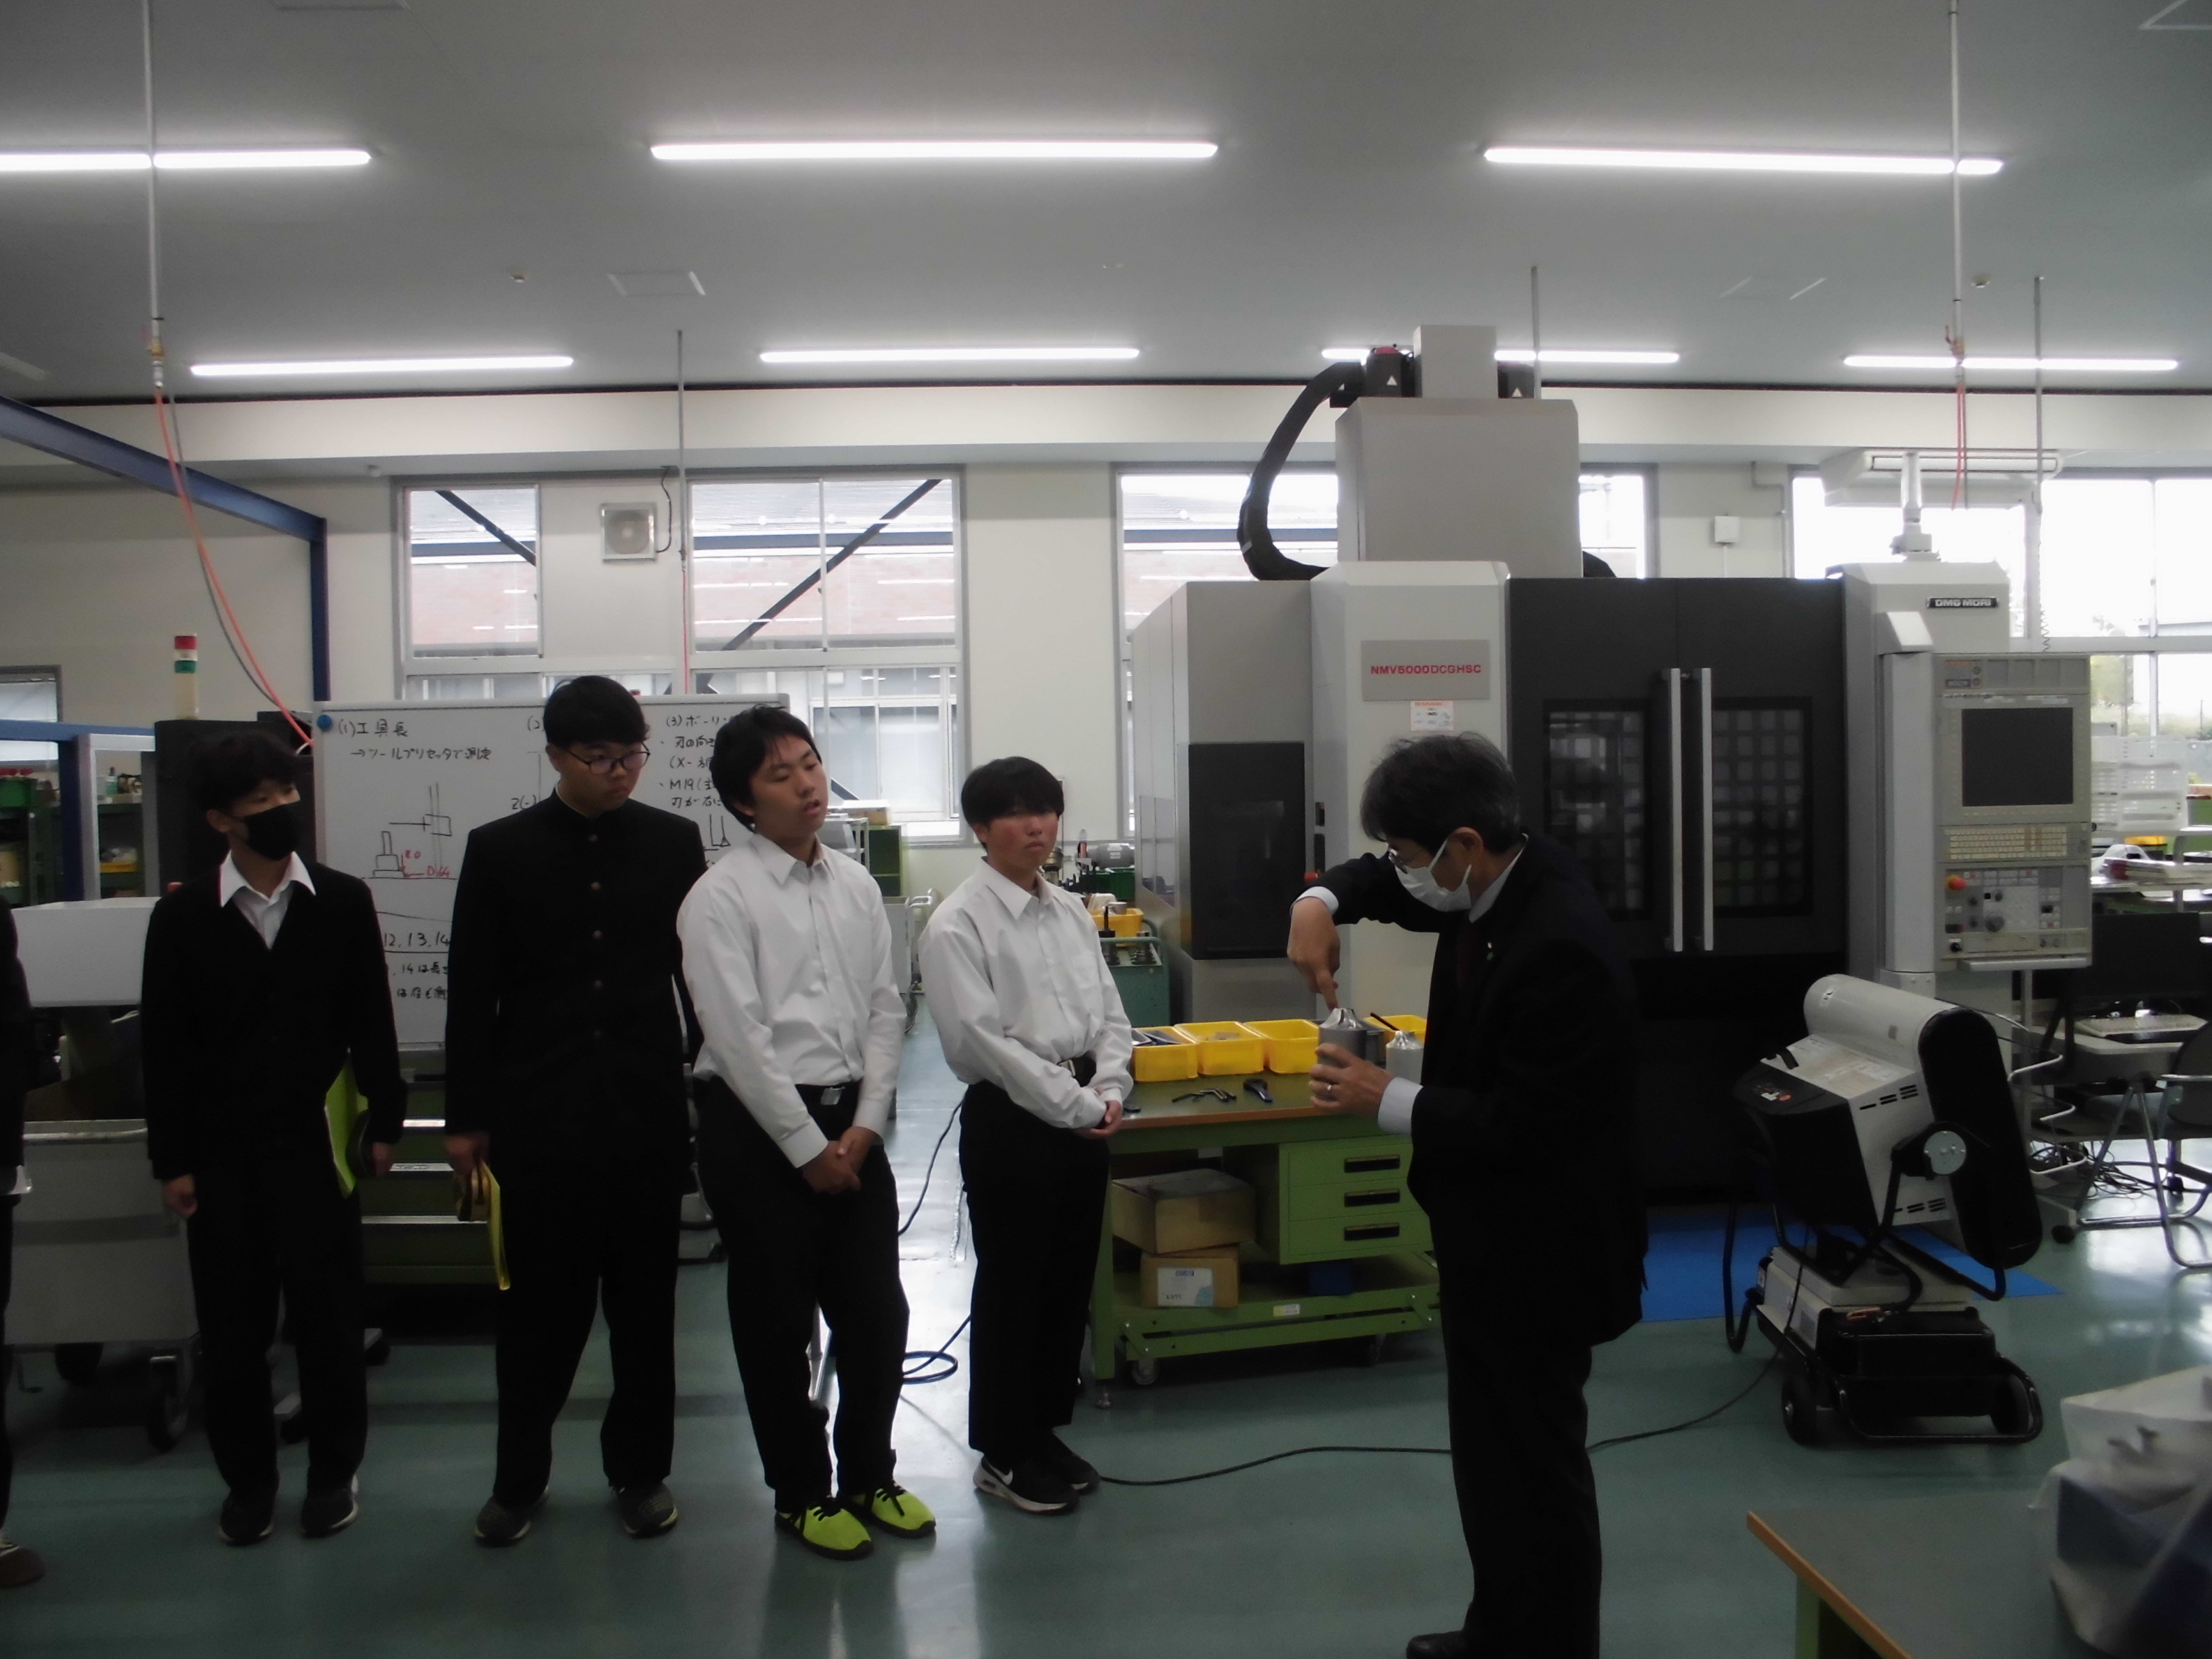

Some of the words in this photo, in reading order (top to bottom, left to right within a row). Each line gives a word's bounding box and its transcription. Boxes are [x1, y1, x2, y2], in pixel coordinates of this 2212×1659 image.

[1934, 598, 1961, 607] DMG
[1962, 598, 1991, 607] MORI
[1370, 664, 1481, 675] NMV5000DCGHSC
